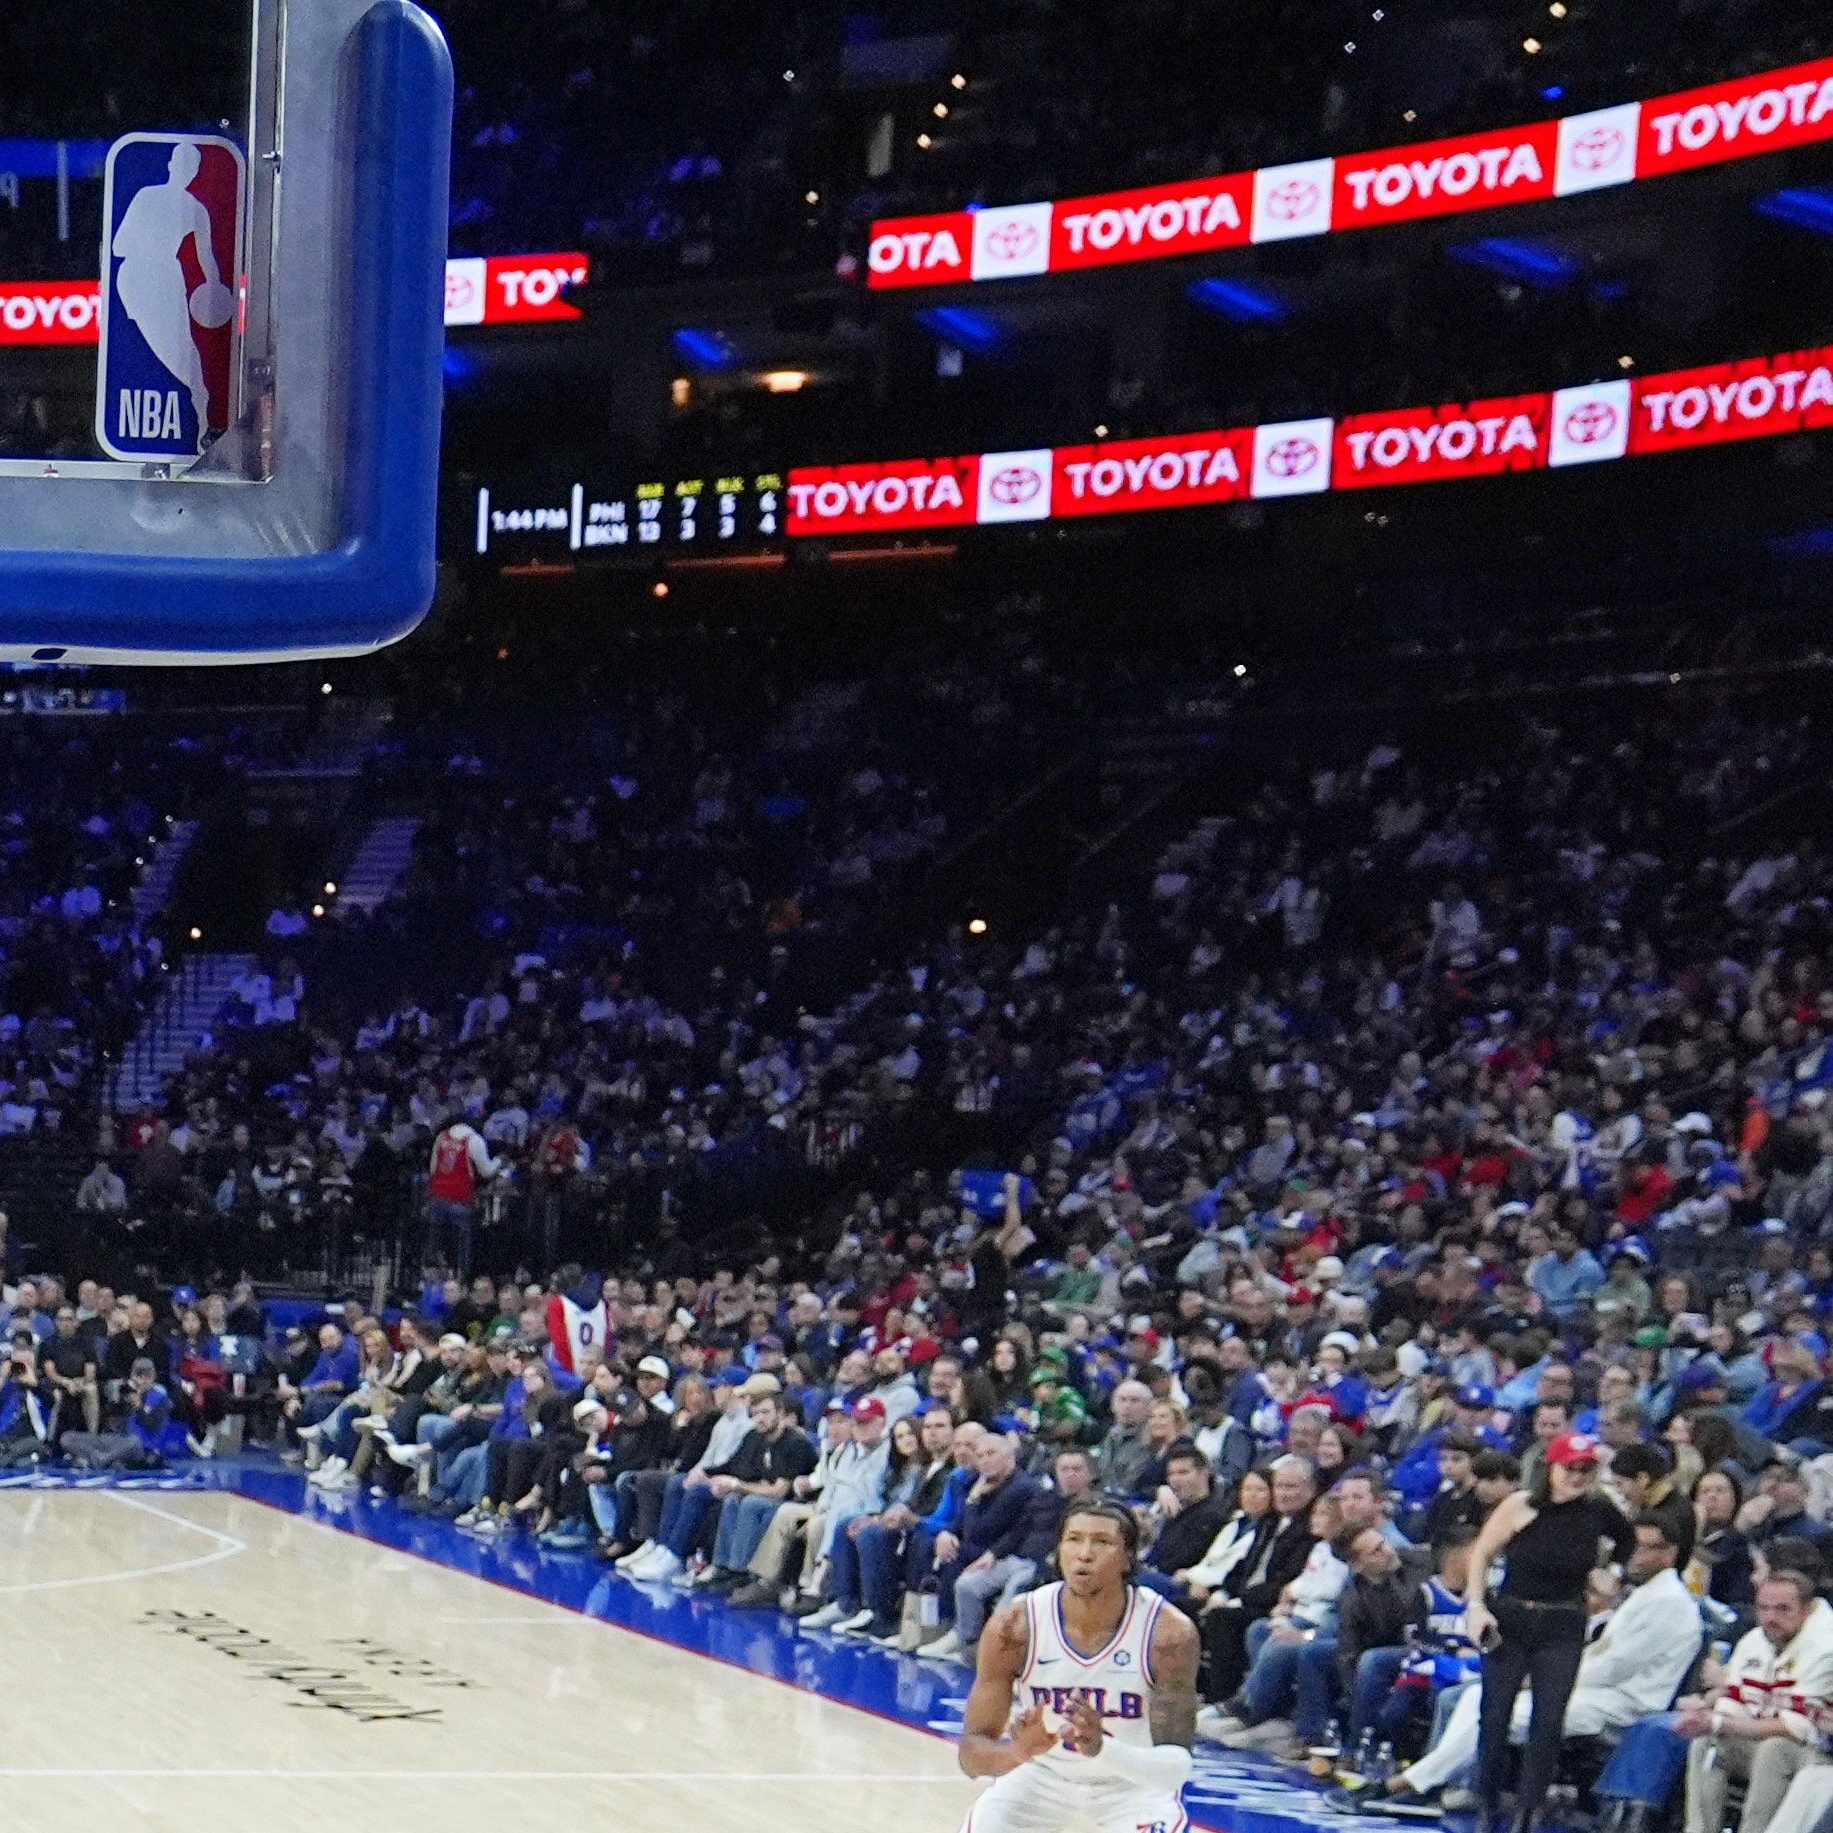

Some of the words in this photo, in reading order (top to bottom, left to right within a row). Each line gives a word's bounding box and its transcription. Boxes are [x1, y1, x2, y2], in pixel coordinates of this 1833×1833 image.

[1650, 76, 1833, 155] TOYOTA
[1345, 143, 1543, 210] TOYOTA
[1063, 194, 1241, 252] TOYOTA
[118, 388, 182, 440] NBA
[1642, 366, 1833, 432] TOYOTA
[1346, 414, 1539, 471] TOYOTA
[788, 473, 963, 519] TOYOTA
[1064, 446, 1240, 499] TOYOTA
